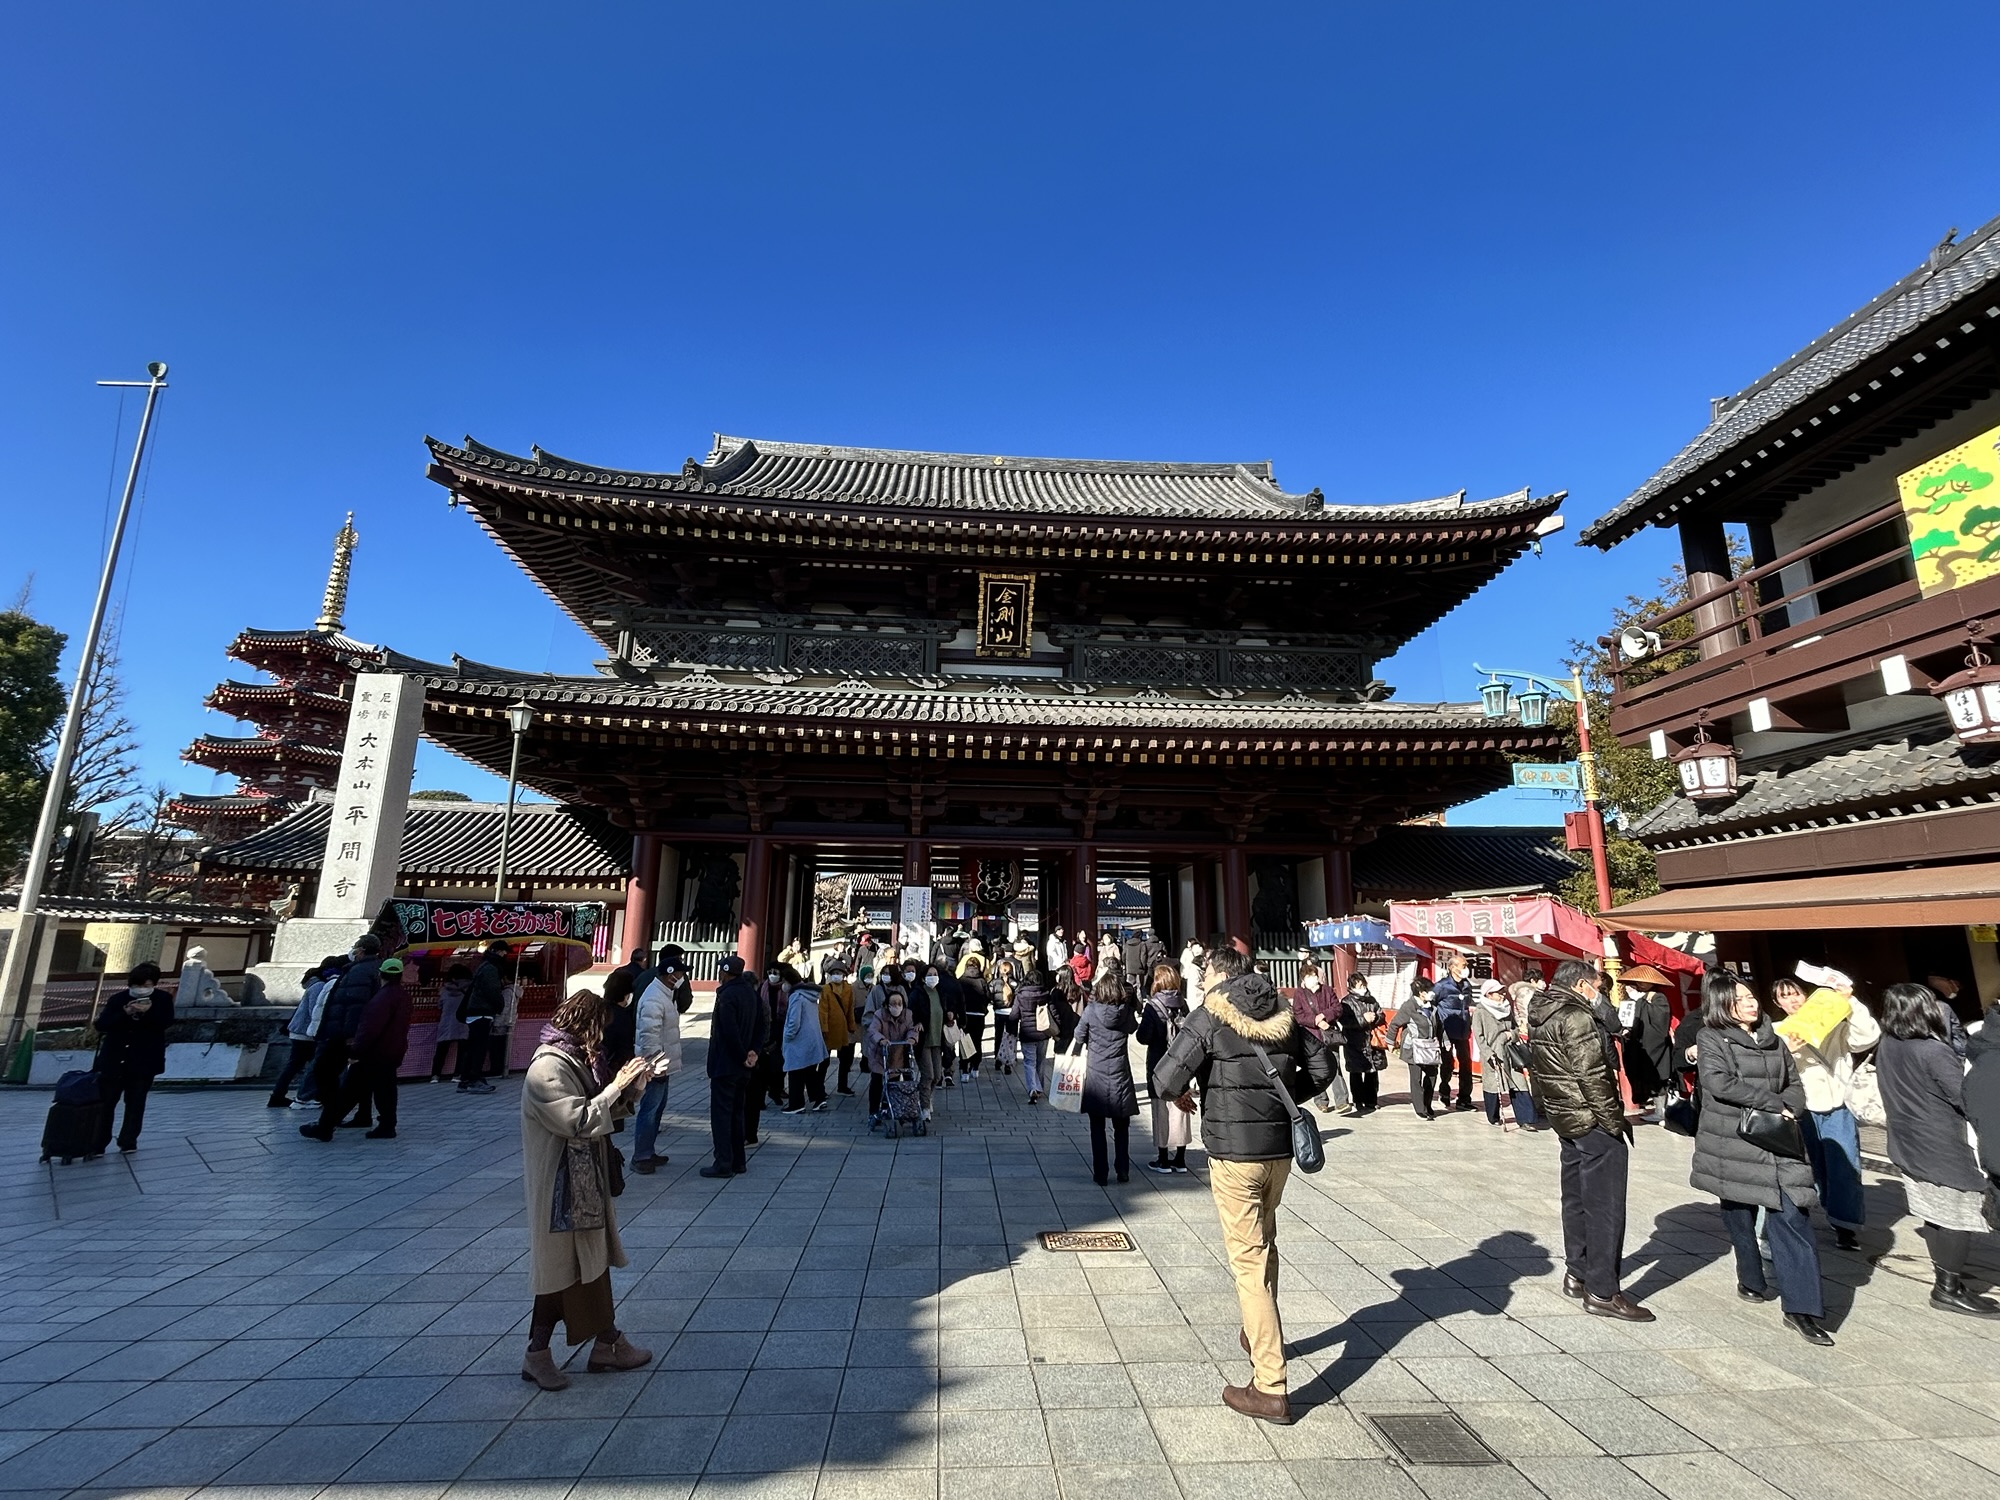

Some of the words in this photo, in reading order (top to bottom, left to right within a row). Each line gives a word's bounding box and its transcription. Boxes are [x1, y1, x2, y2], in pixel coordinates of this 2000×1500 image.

[994, 586, 1018, 643] 金剛山
[333, 732, 378, 899] 大本山平間寺
[431, 908, 570, 937] 七味とうがらし
[1436, 912, 1493, 935] 福豆
